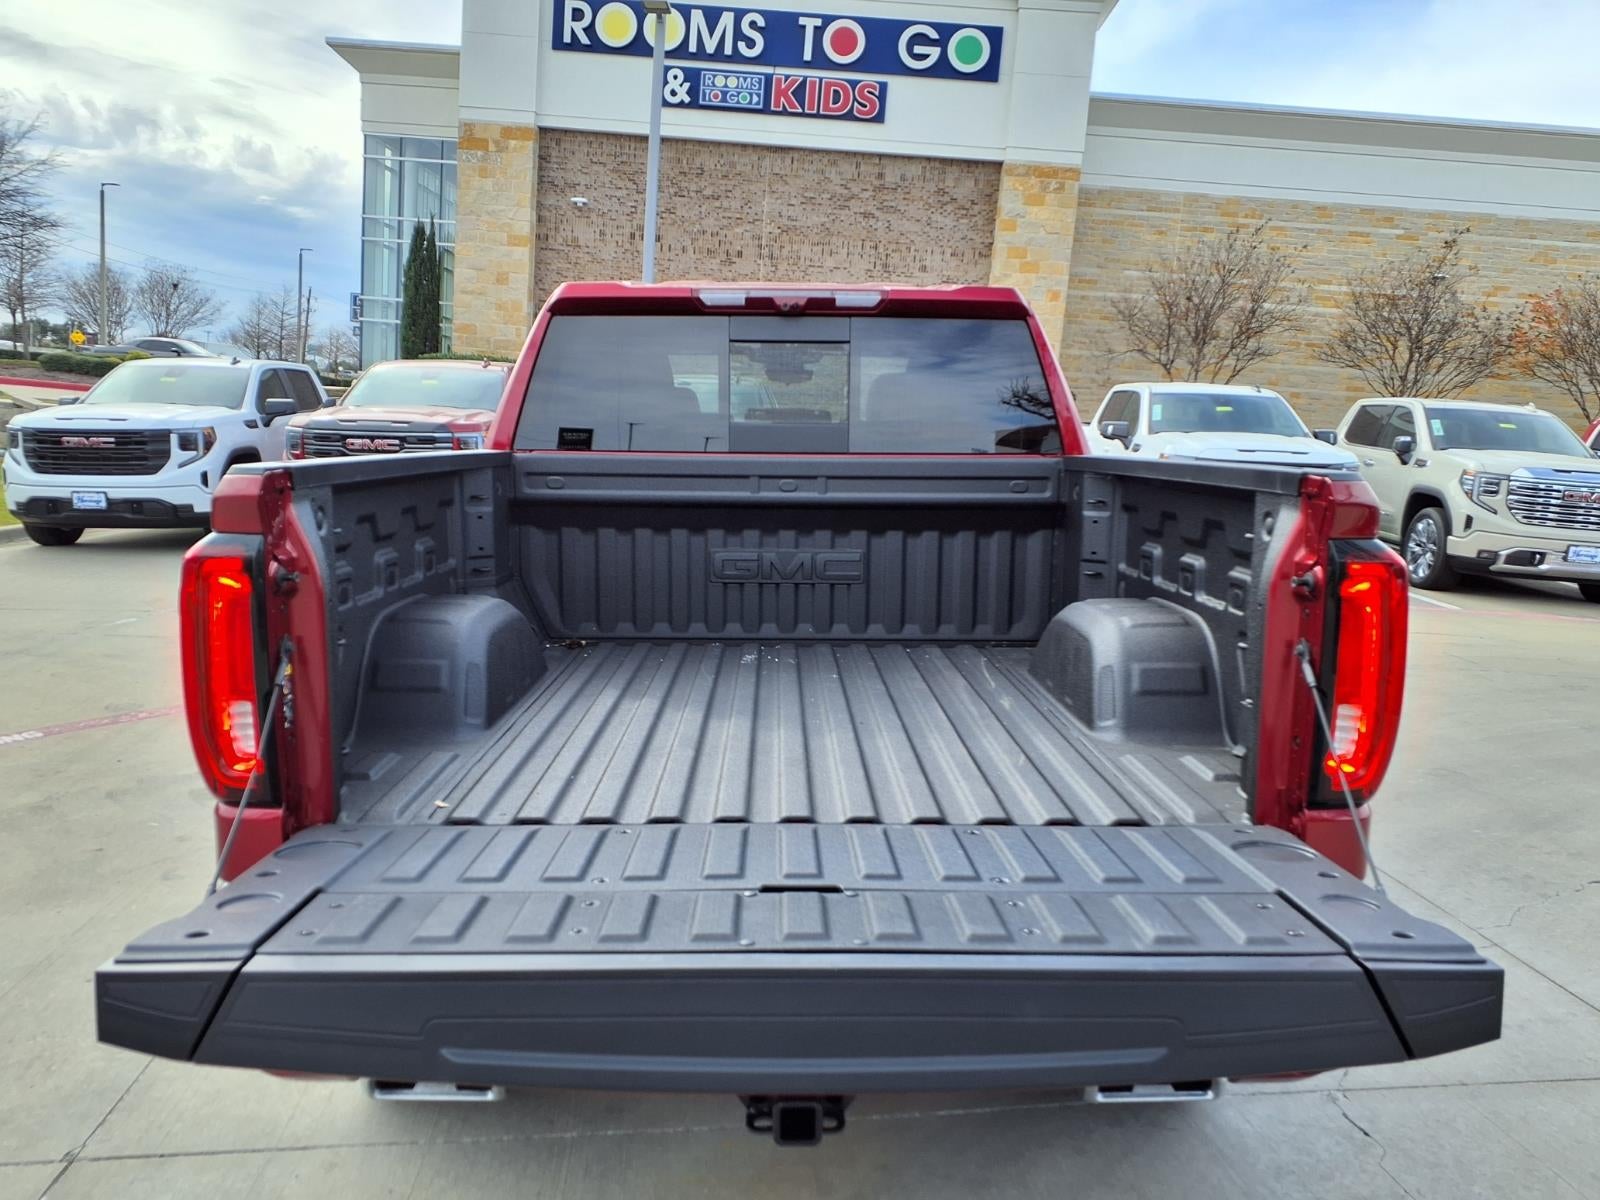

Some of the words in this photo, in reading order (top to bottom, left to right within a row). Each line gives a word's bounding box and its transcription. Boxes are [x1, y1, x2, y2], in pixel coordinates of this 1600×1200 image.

[563, 0, 766, 58] ROOMS
[798, 16, 866, 64] TO
[898, 24, 991, 73] GO
[663, 68, 691, 104] &
[705, 74, 760, 90] ROOMS
[704, 90, 721, 102] TO
[727, 91, 751, 104] GO
[771, 74, 880, 119] KIDS
[60, 437, 116, 447] GMC
[345, 438, 401, 450] GMC
[713, 552, 861, 581] GMC
